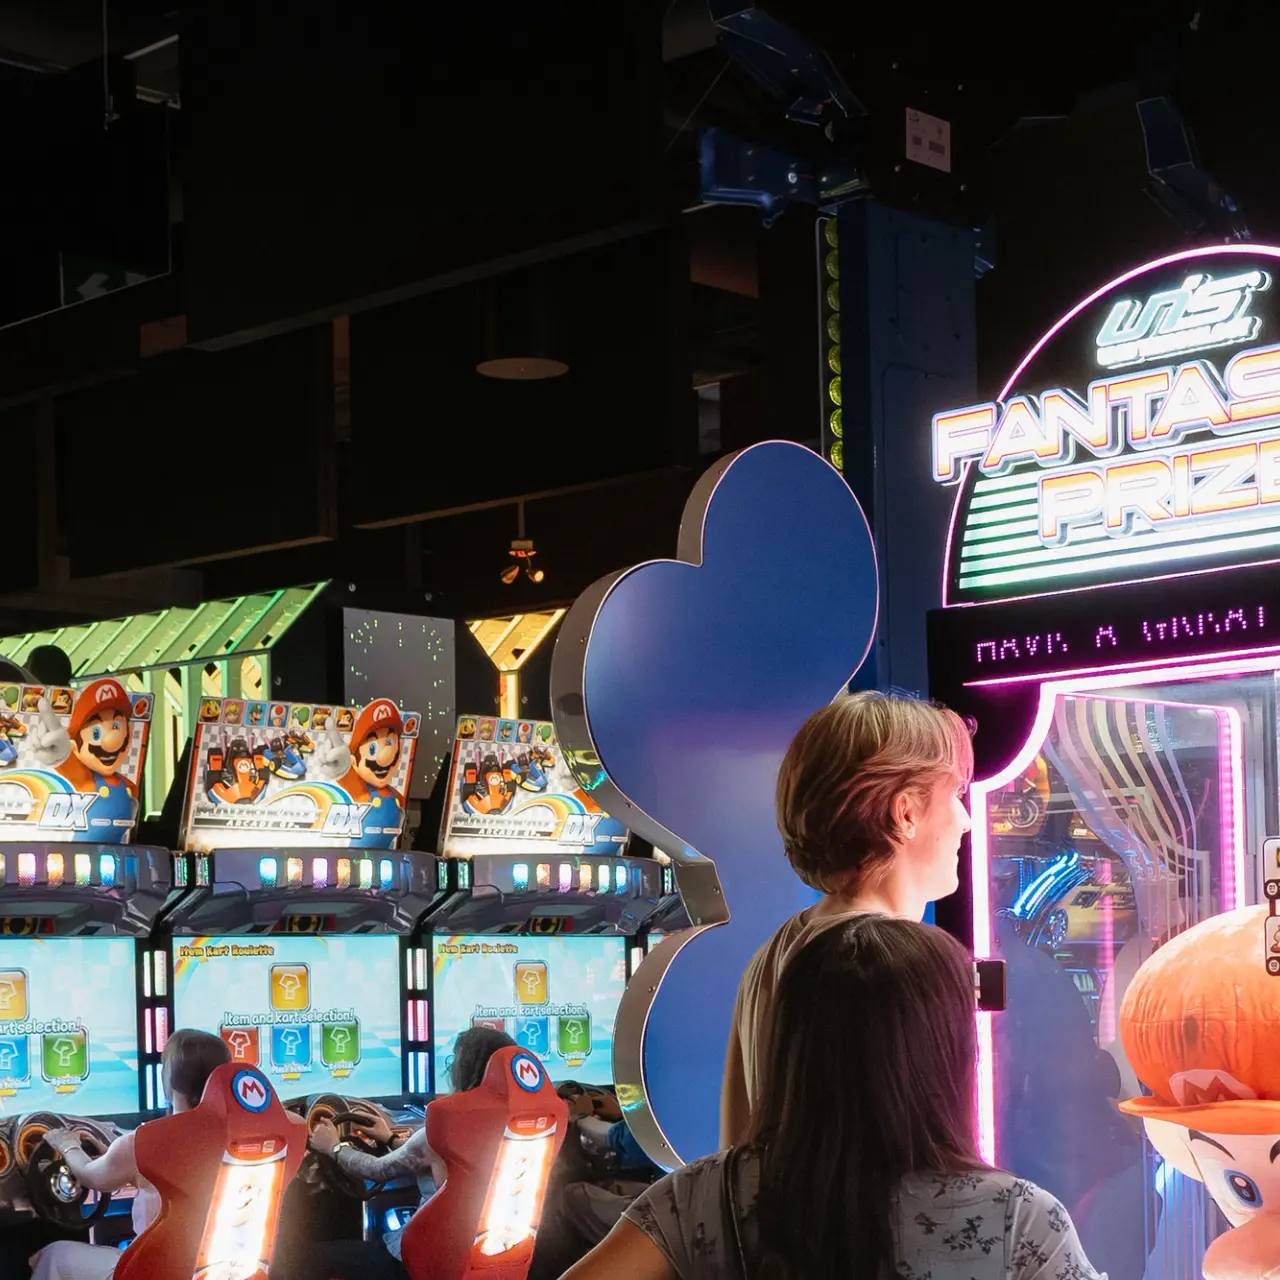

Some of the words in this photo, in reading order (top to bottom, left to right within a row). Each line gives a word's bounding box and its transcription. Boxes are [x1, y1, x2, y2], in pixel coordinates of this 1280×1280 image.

[38, 792, 98, 830] DX
[322, 803, 370, 838] DX
[558, 813, 602, 846] DX
[180, 945, 204, 956] Item
[205, 945, 229, 957] Kart
[231, 944, 274, 956] Roulette
[224, 1012, 251, 1026] Item
[252, 1011, 274, 1025] and
[275, 1010, 300, 1024] kart
[299, 1008, 355, 1023] selection!
[475, 1004, 497, 1017] Item
[499, 1005, 518, 1017] and
[519, 1004, 541, 1017] kart
[540, 1002, 587, 1016] selection!
[16, 1016, 82, 1035] selection!
